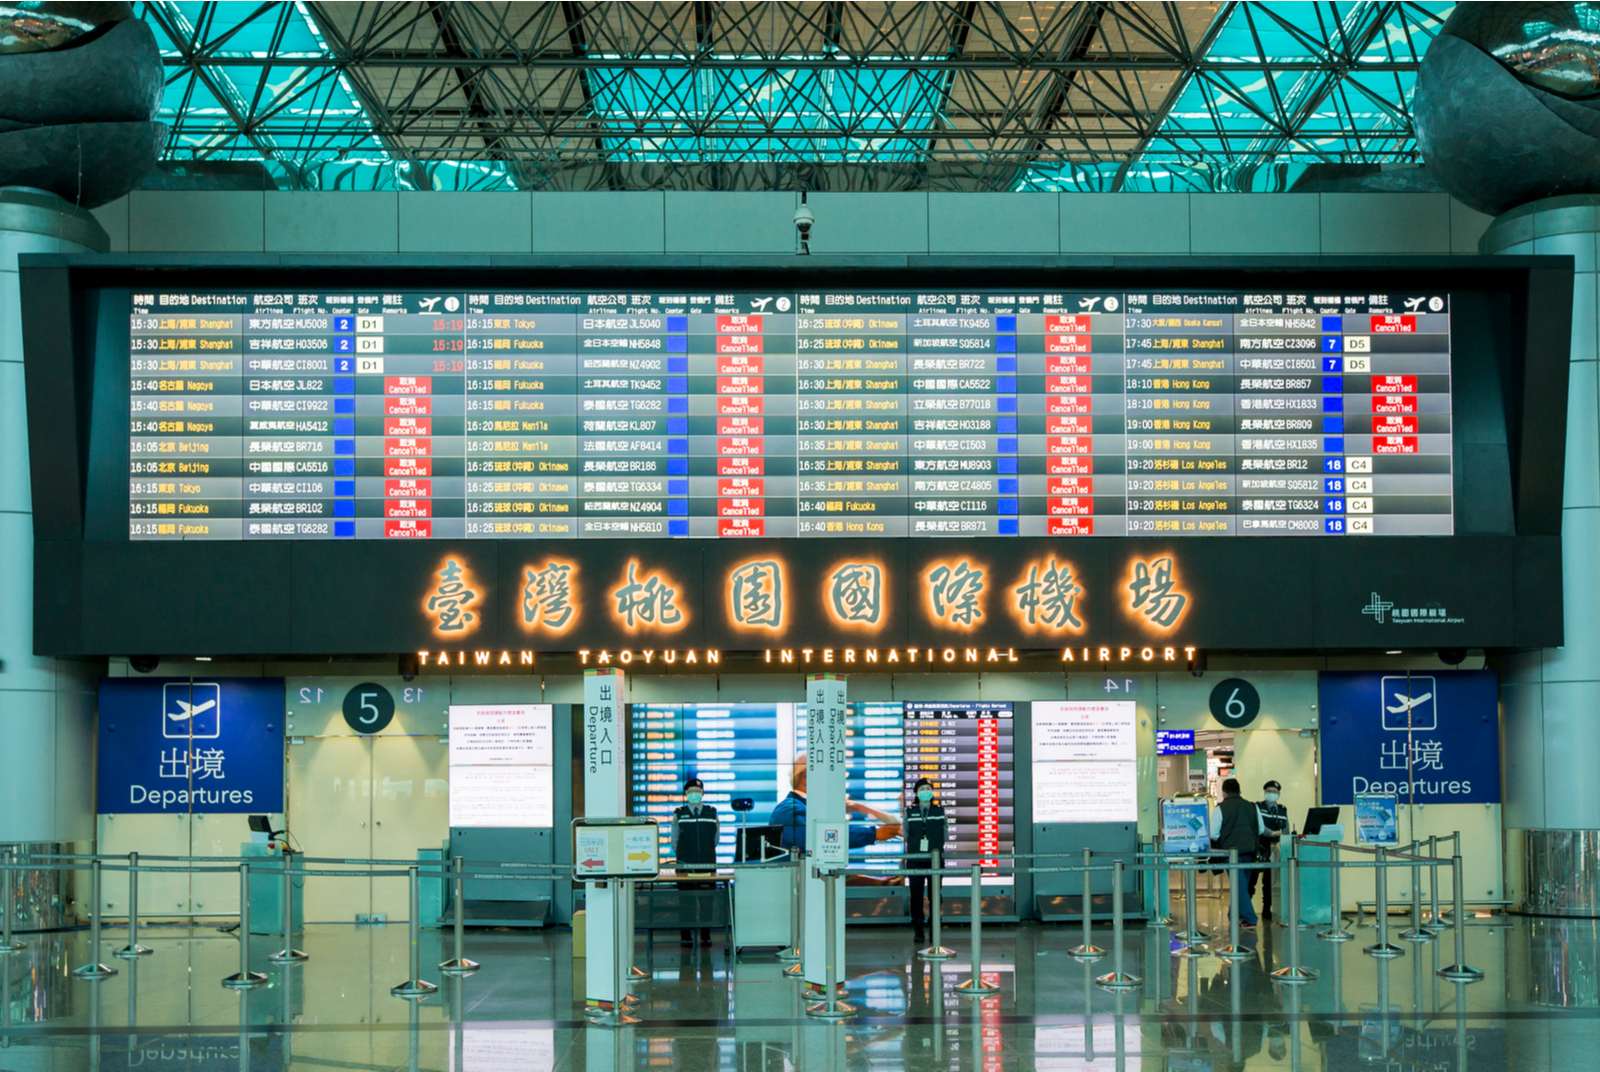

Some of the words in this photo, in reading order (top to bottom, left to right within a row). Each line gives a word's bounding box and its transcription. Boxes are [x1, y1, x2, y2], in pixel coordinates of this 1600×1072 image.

[134, 296, 153, 304] 時間
[160, 296, 188, 304] 目的地
[192, 296, 246, 304] Destination
[254, 295, 292, 304] 航空公司
[383, 296, 401, 304] 備註
[470, 296, 488, 304] 時間
[495, 296, 523, 304] 目的地
[526, 296, 580, 304] Destination
[588, 296, 626, 304] 航空公司
[716, 296, 733, 304] 備註
[801, 296, 819, 304] 時間
[826, 296, 854, 304] 目的地
[856, 296, 910, 304] Destination
[918, 296, 956, 304] 航空公司
[1044, 296, 1061, 304] 備註
[1128, 296, 1146, 304] 時間
[1153, 296, 1180, 304] 目的地
[1244, 296, 1282, 304] 航空公司
[1370, 296, 1387, 304] 備註
[341, 320, 347, 329] 2
[362, 320, 376, 328] D1
[1124, 318, 1152, 328] 17:30
[341, 340, 348, 349] 2
[362, 340, 376, 349] D1
[1125, 338, 1152, 348] 17:45
[1329, 339, 1335, 349] 7
[1350, 340, 1365, 348] D5
[341, 361, 348, 370] 2
[362, 361, 376, 369] D1
[1127, 359, 1152, 369] 17:45
[1329, 360, 1336, 369] 7
[1350, 360, 1365, 369] D5
[1125, 379, 1152, 389] 18:10
[722, 404, 758, 413] Cancelled
[1127, 399, 1153, 409] 18:10
[1128, 420, 1153, 429] 19:00
[1128, 440, 1153, 449] 19:00
[1126, 460, 1154, 469] 19:20
[1328, 460, 1341, 470] 18
[1351, 461, 1366, 469] C4
[1128, 480, 1154, 490] 19:20
[1328, 481, 1341, 490] 18
[1352, 481, 1366, 489] C4
[1127, 500, 1154, 510] 19:20
[1328, 501, 1342, 510] 18
[1352, 501, 1367, 510] C4
[1129, 520, 1154, 530] 19:20
[1328, 521, 1342, 530] 18
[1352, 521, 1367, 530] C4
[425, 556, 1189, 631] 臺灣桃園國際機場
[419, 652, 534, 665] TAIWAN
[580, 650, 720, 664] TAOYUAN
[766, 650, 1018, 664] INTERNATIONAL
[1062, 647, 1196, 662] AIRPORT
[359, 692, 379, 724] 5
[1225, 688, 1245, 718] 6
[600, 684, 612, 765] 出境入口
[816, 689, 825, 763] 出境入口
[836, 689, 845, 763] 出境入口
[588, 706, 598, 774] Departure
[1380, 740, 1444, 770] 出境
[159, 748, 226, 780] 出境
[1353, 776, 1472, 794] Departures
[130, 785, 254, 808] Departures
